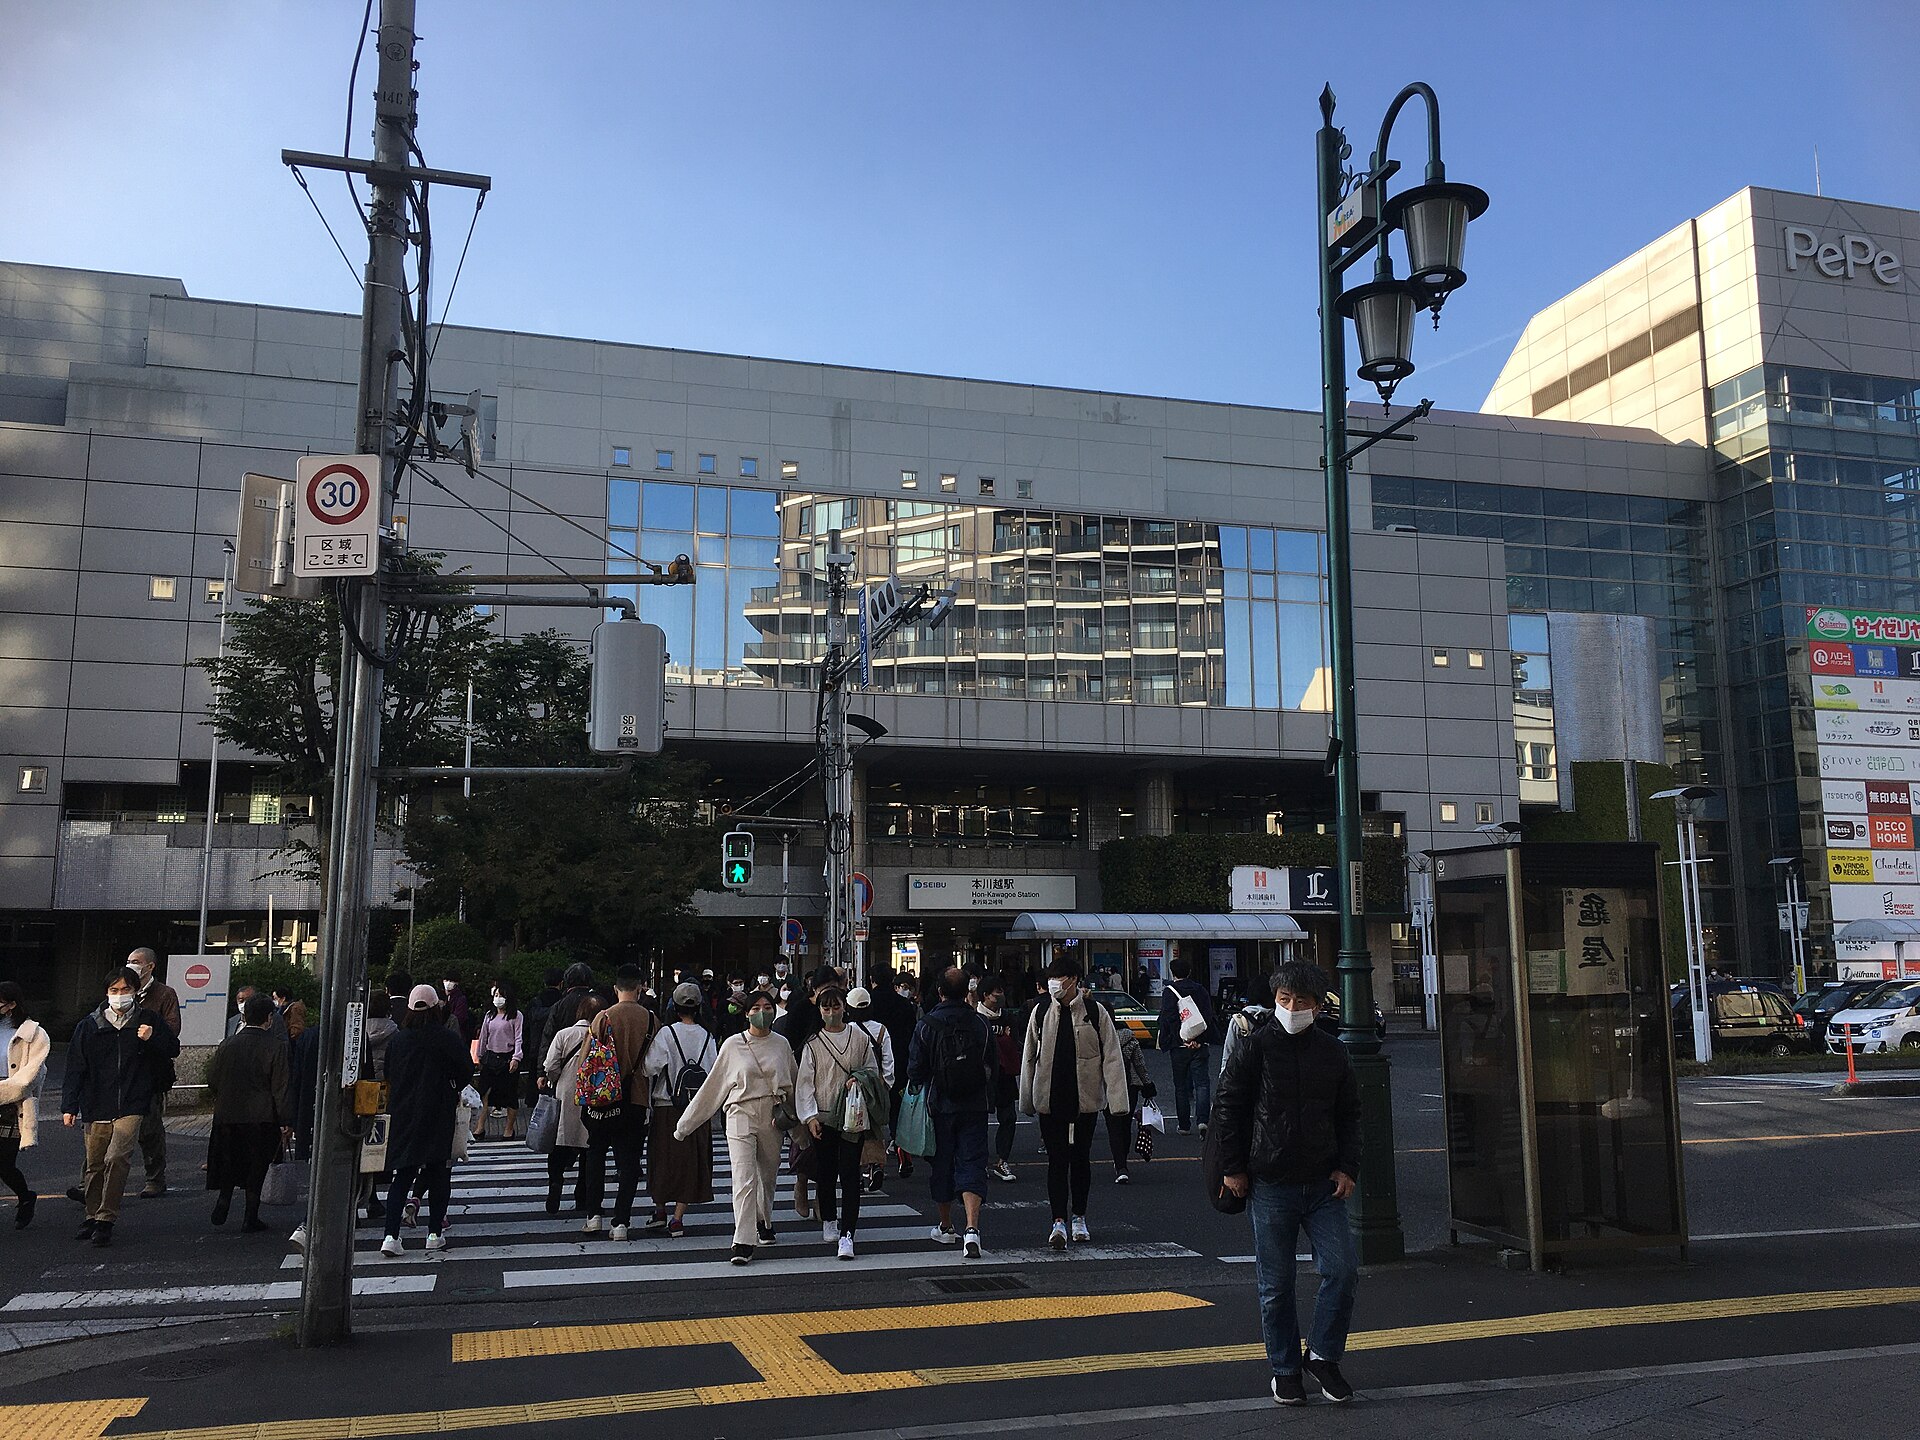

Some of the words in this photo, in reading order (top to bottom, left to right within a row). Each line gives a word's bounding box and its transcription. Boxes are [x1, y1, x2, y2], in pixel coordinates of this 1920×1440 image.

[1784, 226, 1904, 285] PePe
[320, 481, 356, 508] 30
[321, 538, 352, 551] 区域
[308, 553, 364, 566] ここまで
[622, 715, 635, 725] SD
[622, 726, 634, 735] 25
[1822, 755, 1861, 770] grove
[1867, 762, 1887, 770] CLIP
[1869, 791, 1909, 804] 無印良品
[1829, 825, 1851, 834] Watts
[1875, 821, 1906, 831] DECO
[1877, 833, 1907, 843] HOME
[971, 878, 1015, 890] 本川越駅
[1254, 871, 1267, 887] H
[923, 881, 947, 889] SEIBU
[971, 891, 1016, 899] Hon-Kawagoe
